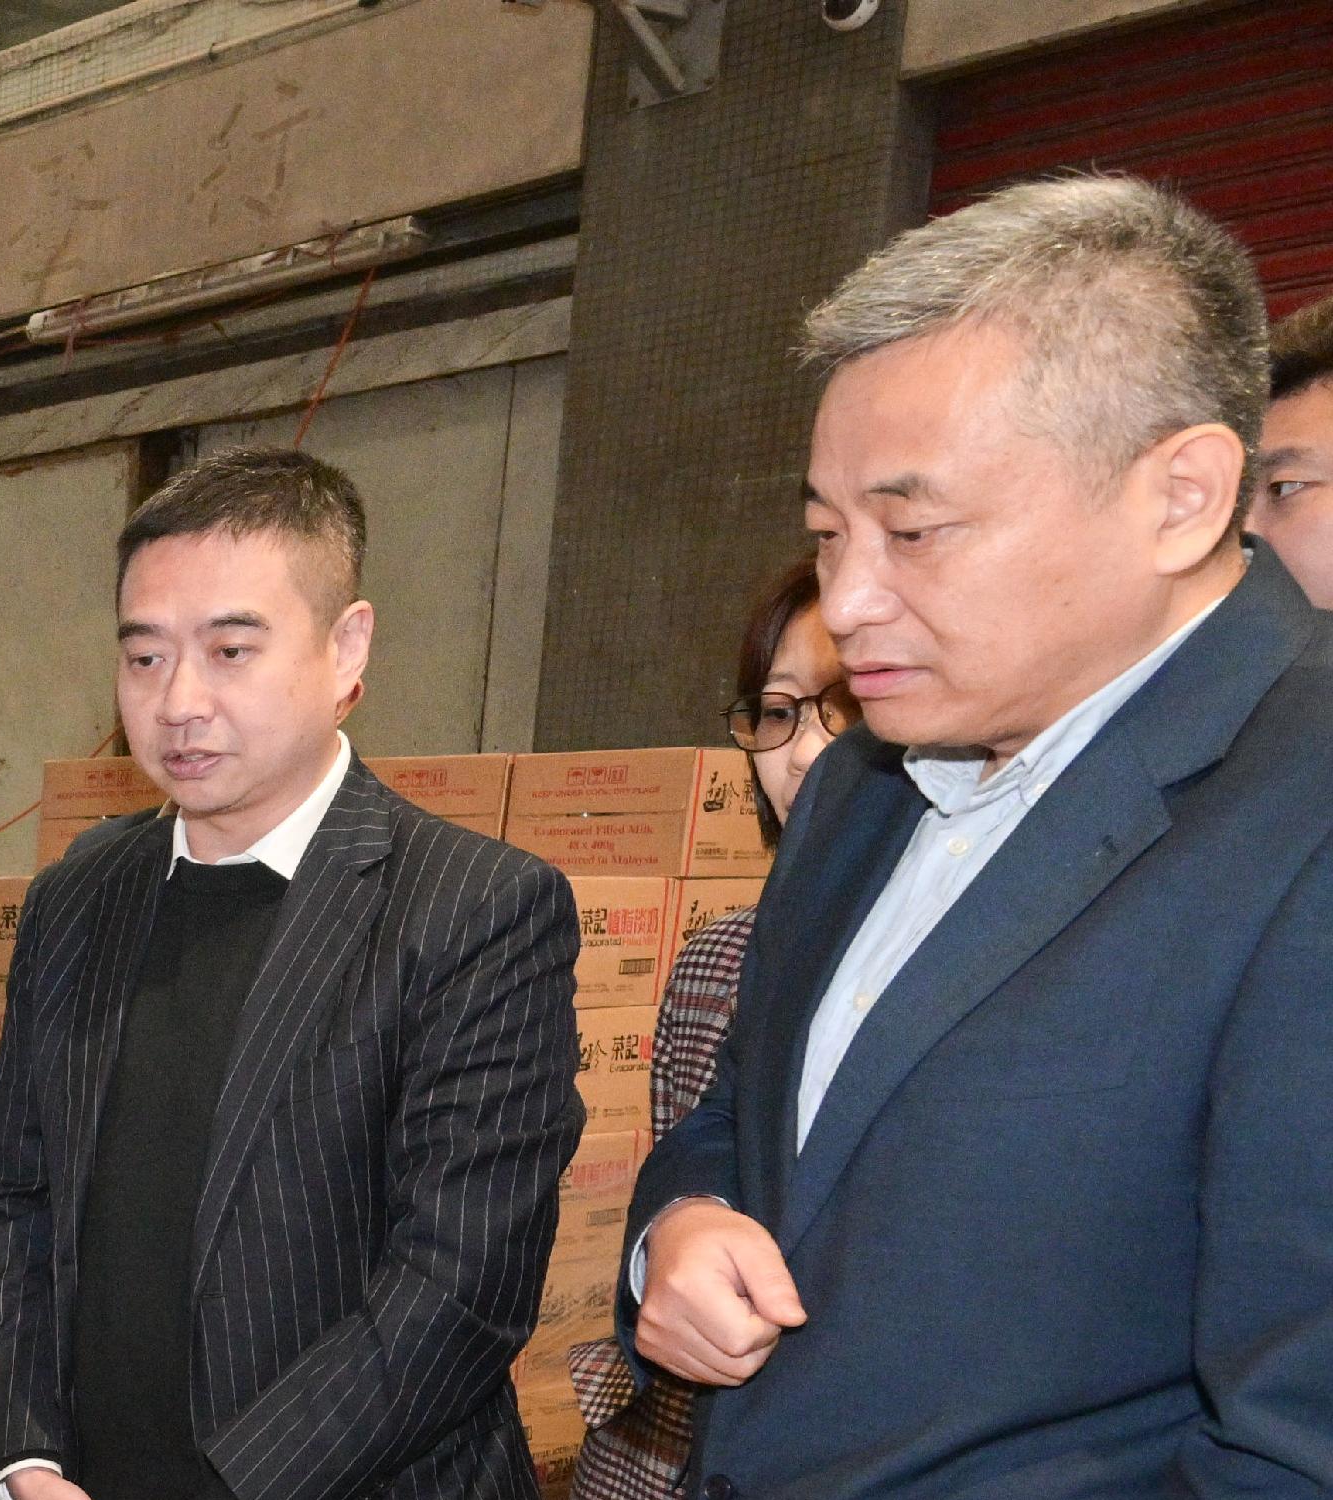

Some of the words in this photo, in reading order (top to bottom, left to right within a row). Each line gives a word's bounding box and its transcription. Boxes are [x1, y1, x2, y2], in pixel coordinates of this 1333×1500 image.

[533, 825, 592, 836] Evaporated
[596, 824, 625, 835] Filled
[630, 824, 654, 834] Milk
[598, 856, 608, 865] in
[613, 855, 659, 866] Malaysia
